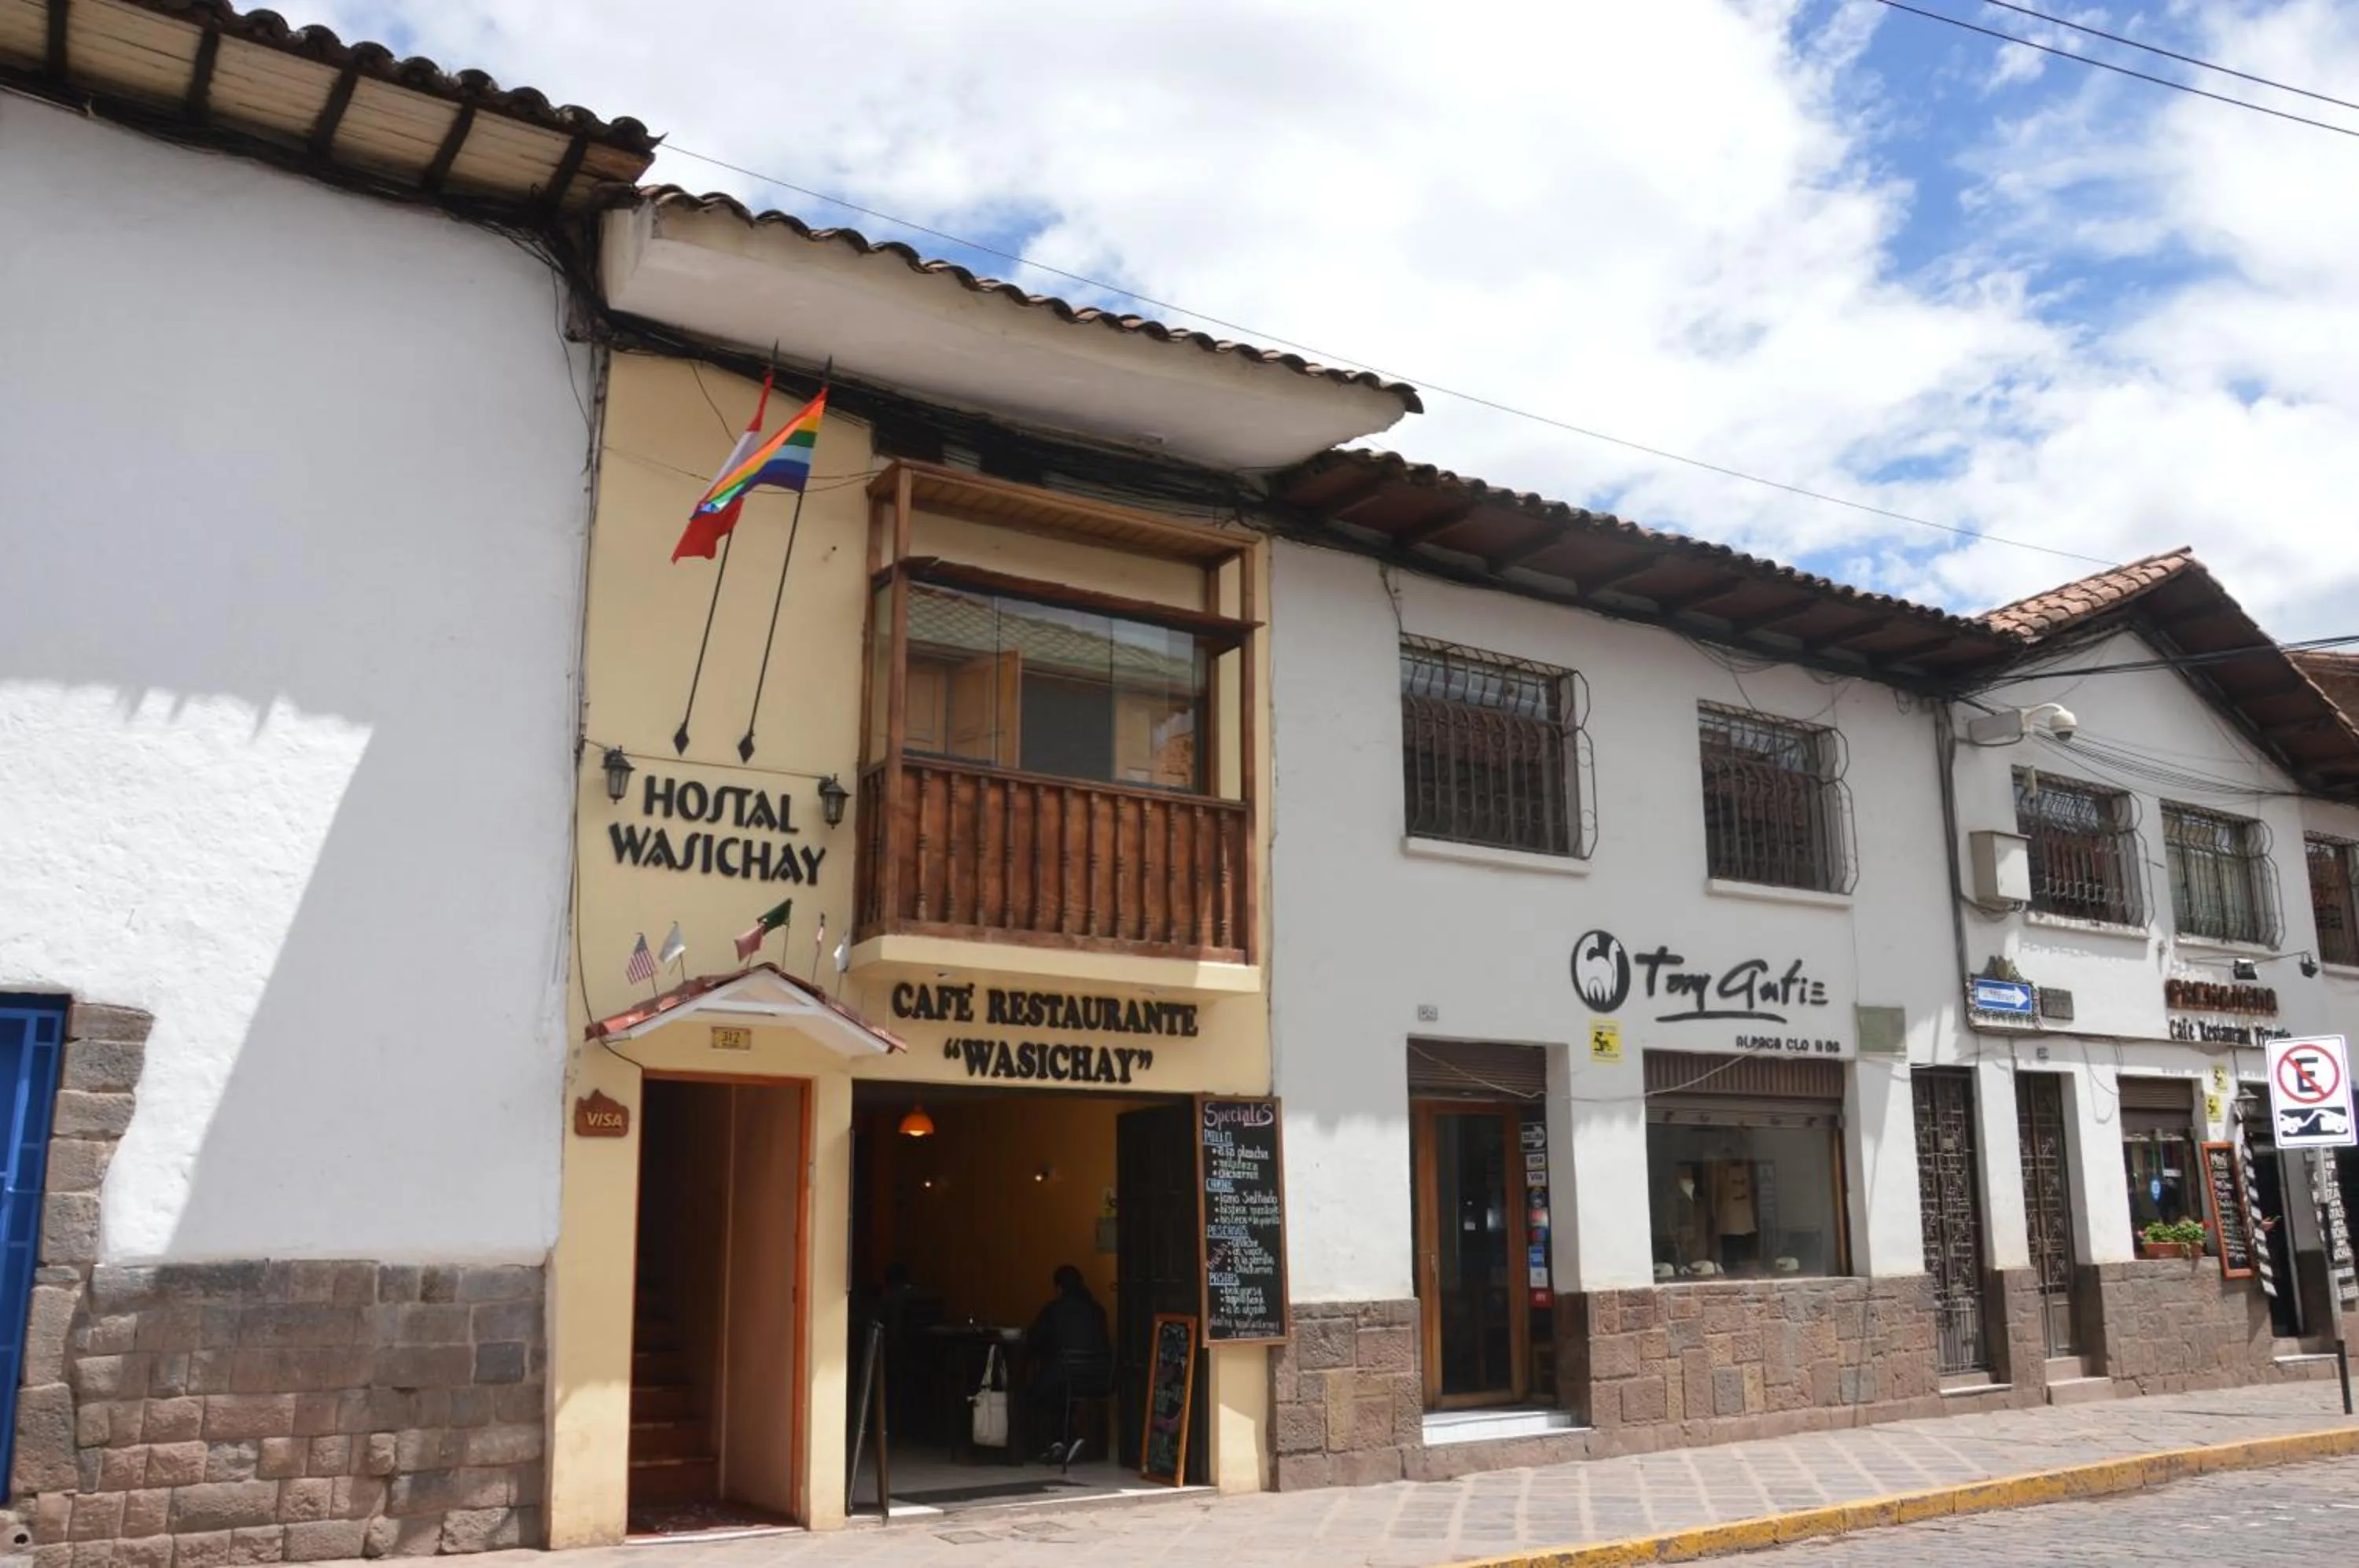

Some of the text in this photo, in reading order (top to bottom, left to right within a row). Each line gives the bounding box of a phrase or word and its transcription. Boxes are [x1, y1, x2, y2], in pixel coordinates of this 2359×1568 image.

[642, 775, 799, 834] HOSTAL
[608, 822, 826, 885] WASICHAY
[988, 989, 1199, 1037] RESTAURANTE
[2295, 1056, 2319, 1093] E
[586, 1111, 624, 1128] VISA
